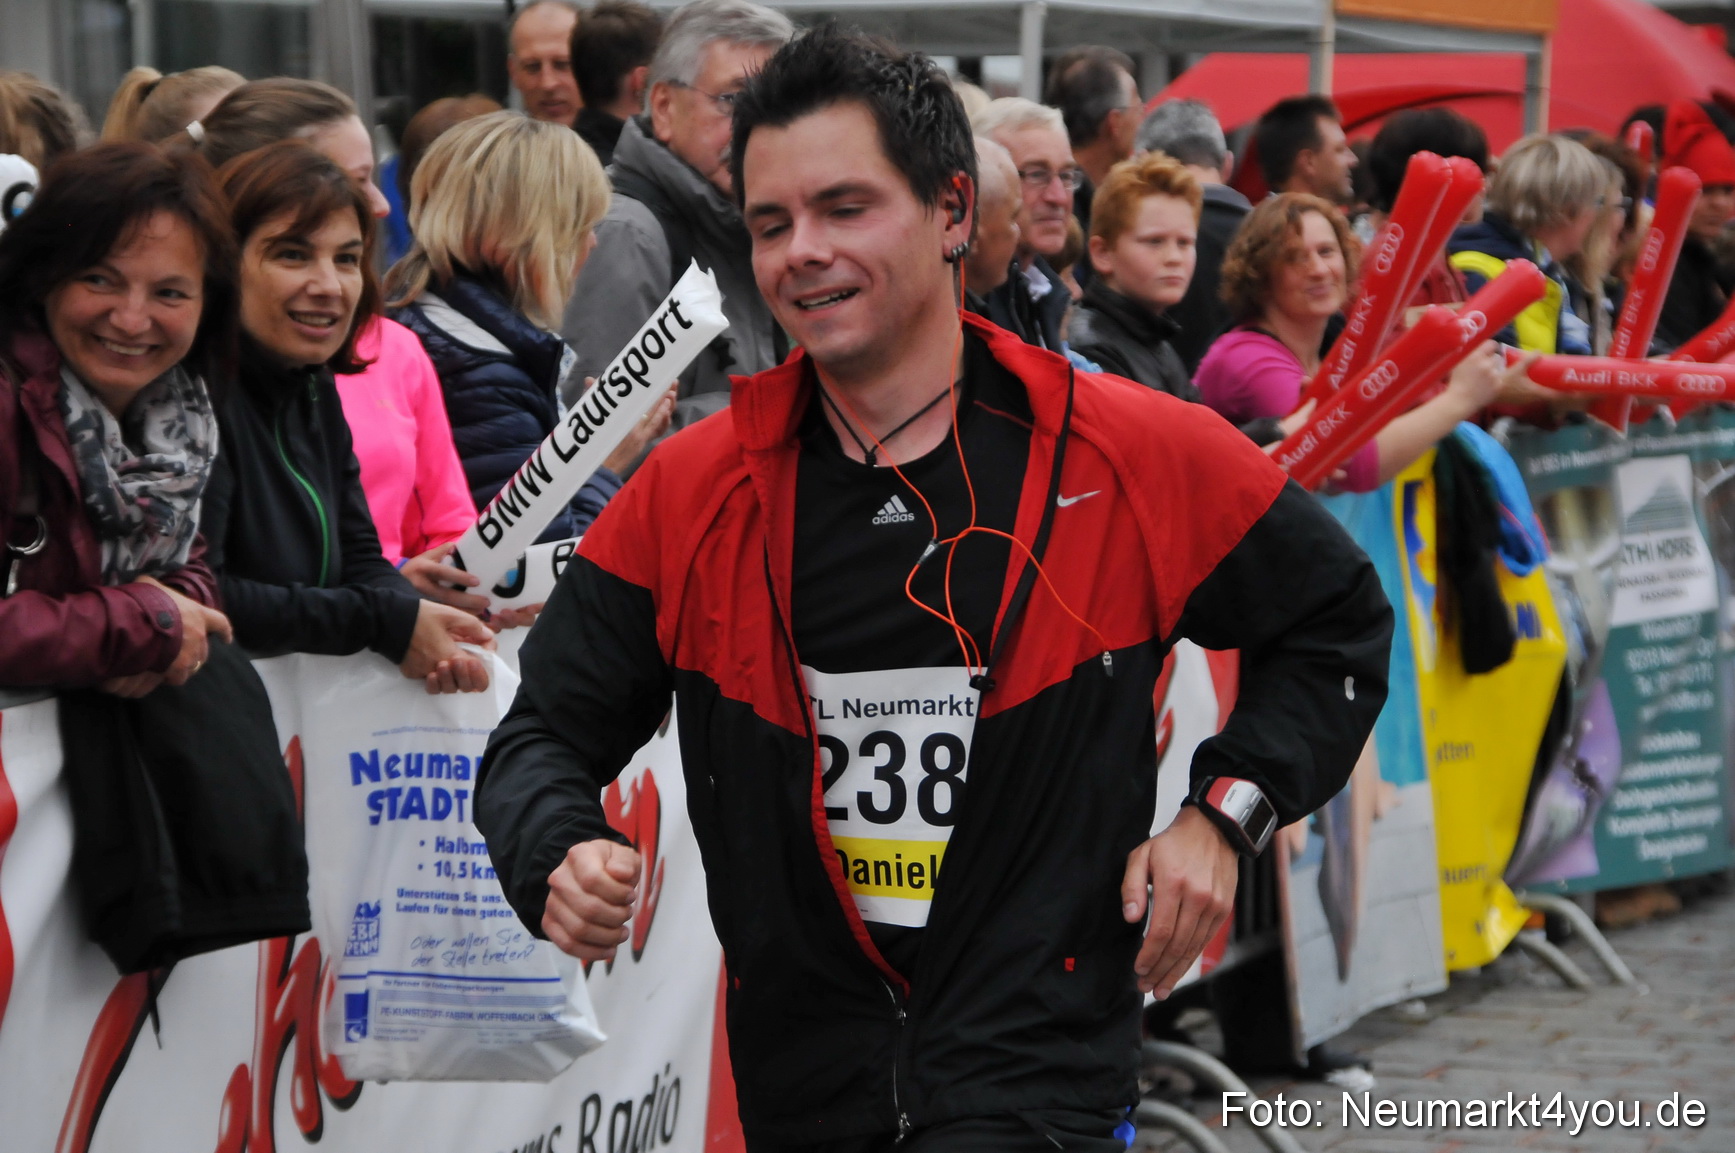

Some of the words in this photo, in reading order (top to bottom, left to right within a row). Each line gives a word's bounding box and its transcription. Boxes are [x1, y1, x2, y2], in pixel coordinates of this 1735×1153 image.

[1329, 338, 1358, 390] Audi
[1351, 293, 1377, 336] BKK
[1564, 367, 1612, 385] Audi
[1617, 370, 1660, 388] BKK
[475, 444, 553, 549] BMW
[550, 297, 693, 464] Laufsport
[1279, 431, 1320, 470] Audi
[1316, 400, 1352, 438] BKK
[872, 512, 915, 525] adidas
[842, 693, 974, 720] Neumarkt
[816, 729, 968, 828] 238
[434, 860, 468, 881] 10,5
[480, 908, 513, 920] guten
[578, 1061, 681, 1153] Radio
